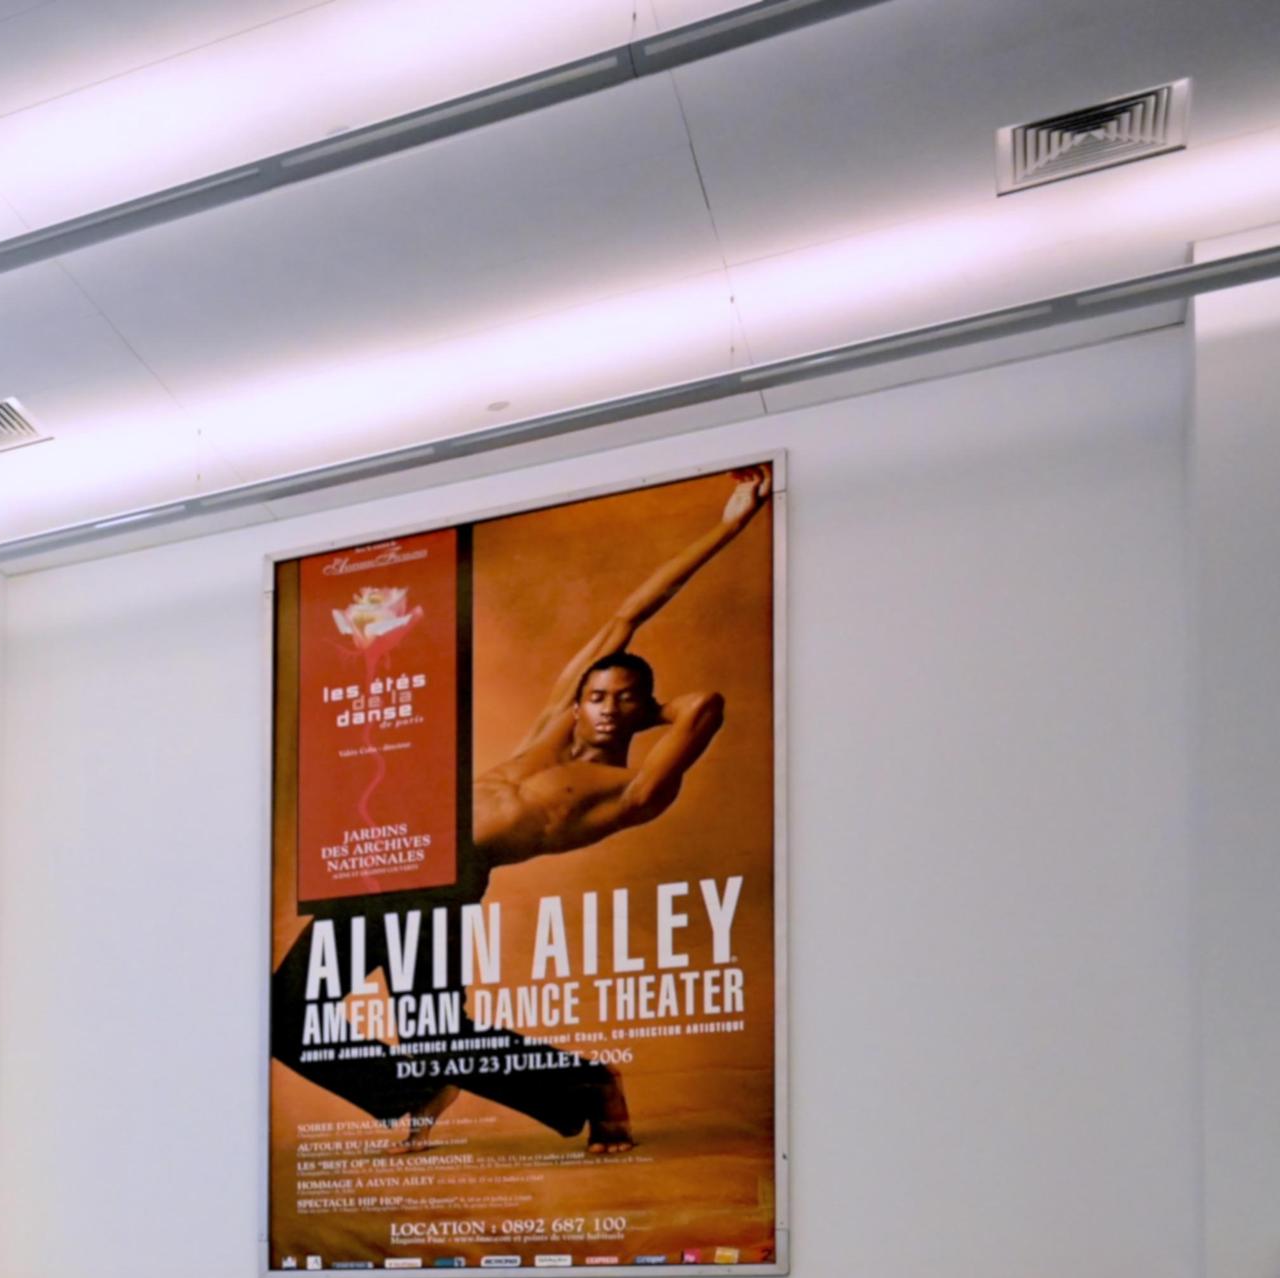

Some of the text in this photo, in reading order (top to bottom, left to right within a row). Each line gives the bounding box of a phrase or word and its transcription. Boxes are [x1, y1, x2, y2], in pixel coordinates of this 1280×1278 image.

[323, 673, 427, 703] les étés
[351, 689, 412, 711] de la
[336, 703, 412, 728] danse
[343, 823, 408, 844] JARDINS
[321, 834, 432, 859] DES ARCHIVES
[326, 849, 425, 872] NATIONALES
[305, 876, 743, 1000] ALVIN AILEY
[302, 968, 745, 1045] AMERICAN DANCE THEATER
[300, 1049, 335, 1062] JUDITH
[390, 1041, 447, 1056] DIRECTRICE
[450, 1036, 511, 1051] ARTISTIQUE
[612, 1027, 682, 1040] CO-DIRECTEUR
[686, 1020, 745, 1035] ARTISTIQUE
[396, 1047, 633, 1079] DU 3 AU 23 JUILLET 2006
[298, 1141, 342, 1153] AUTOUR
[345, 1140, 361, 1150] DU
[364, 1138, 390, 1151] JAZZ
[297, 1161, 316, 1171] LES
[372, 1157, 387, 1168] DE
[390, 1156, 404, 1167] LA
[406, 1154, 474, 1166] COMPAGNIE
[297, 1178, 352, 1190] HOMMAGE
[366, 1177, 400, 1188] ALVIN
[403, 1175, 434, 1187] AILEY
[296, 1199, 355, 1210] SPECTACLE
[358, 1197, 377, 1207] HIP
[380, 1196, 403, 1206] HOP
[390, 1221, 485, 1236] LOCATION
[501, 1218, 545, 1234] 0892
[551, 1217, 585, 1233] 687
[594, 1216, 627, 1232] 100
